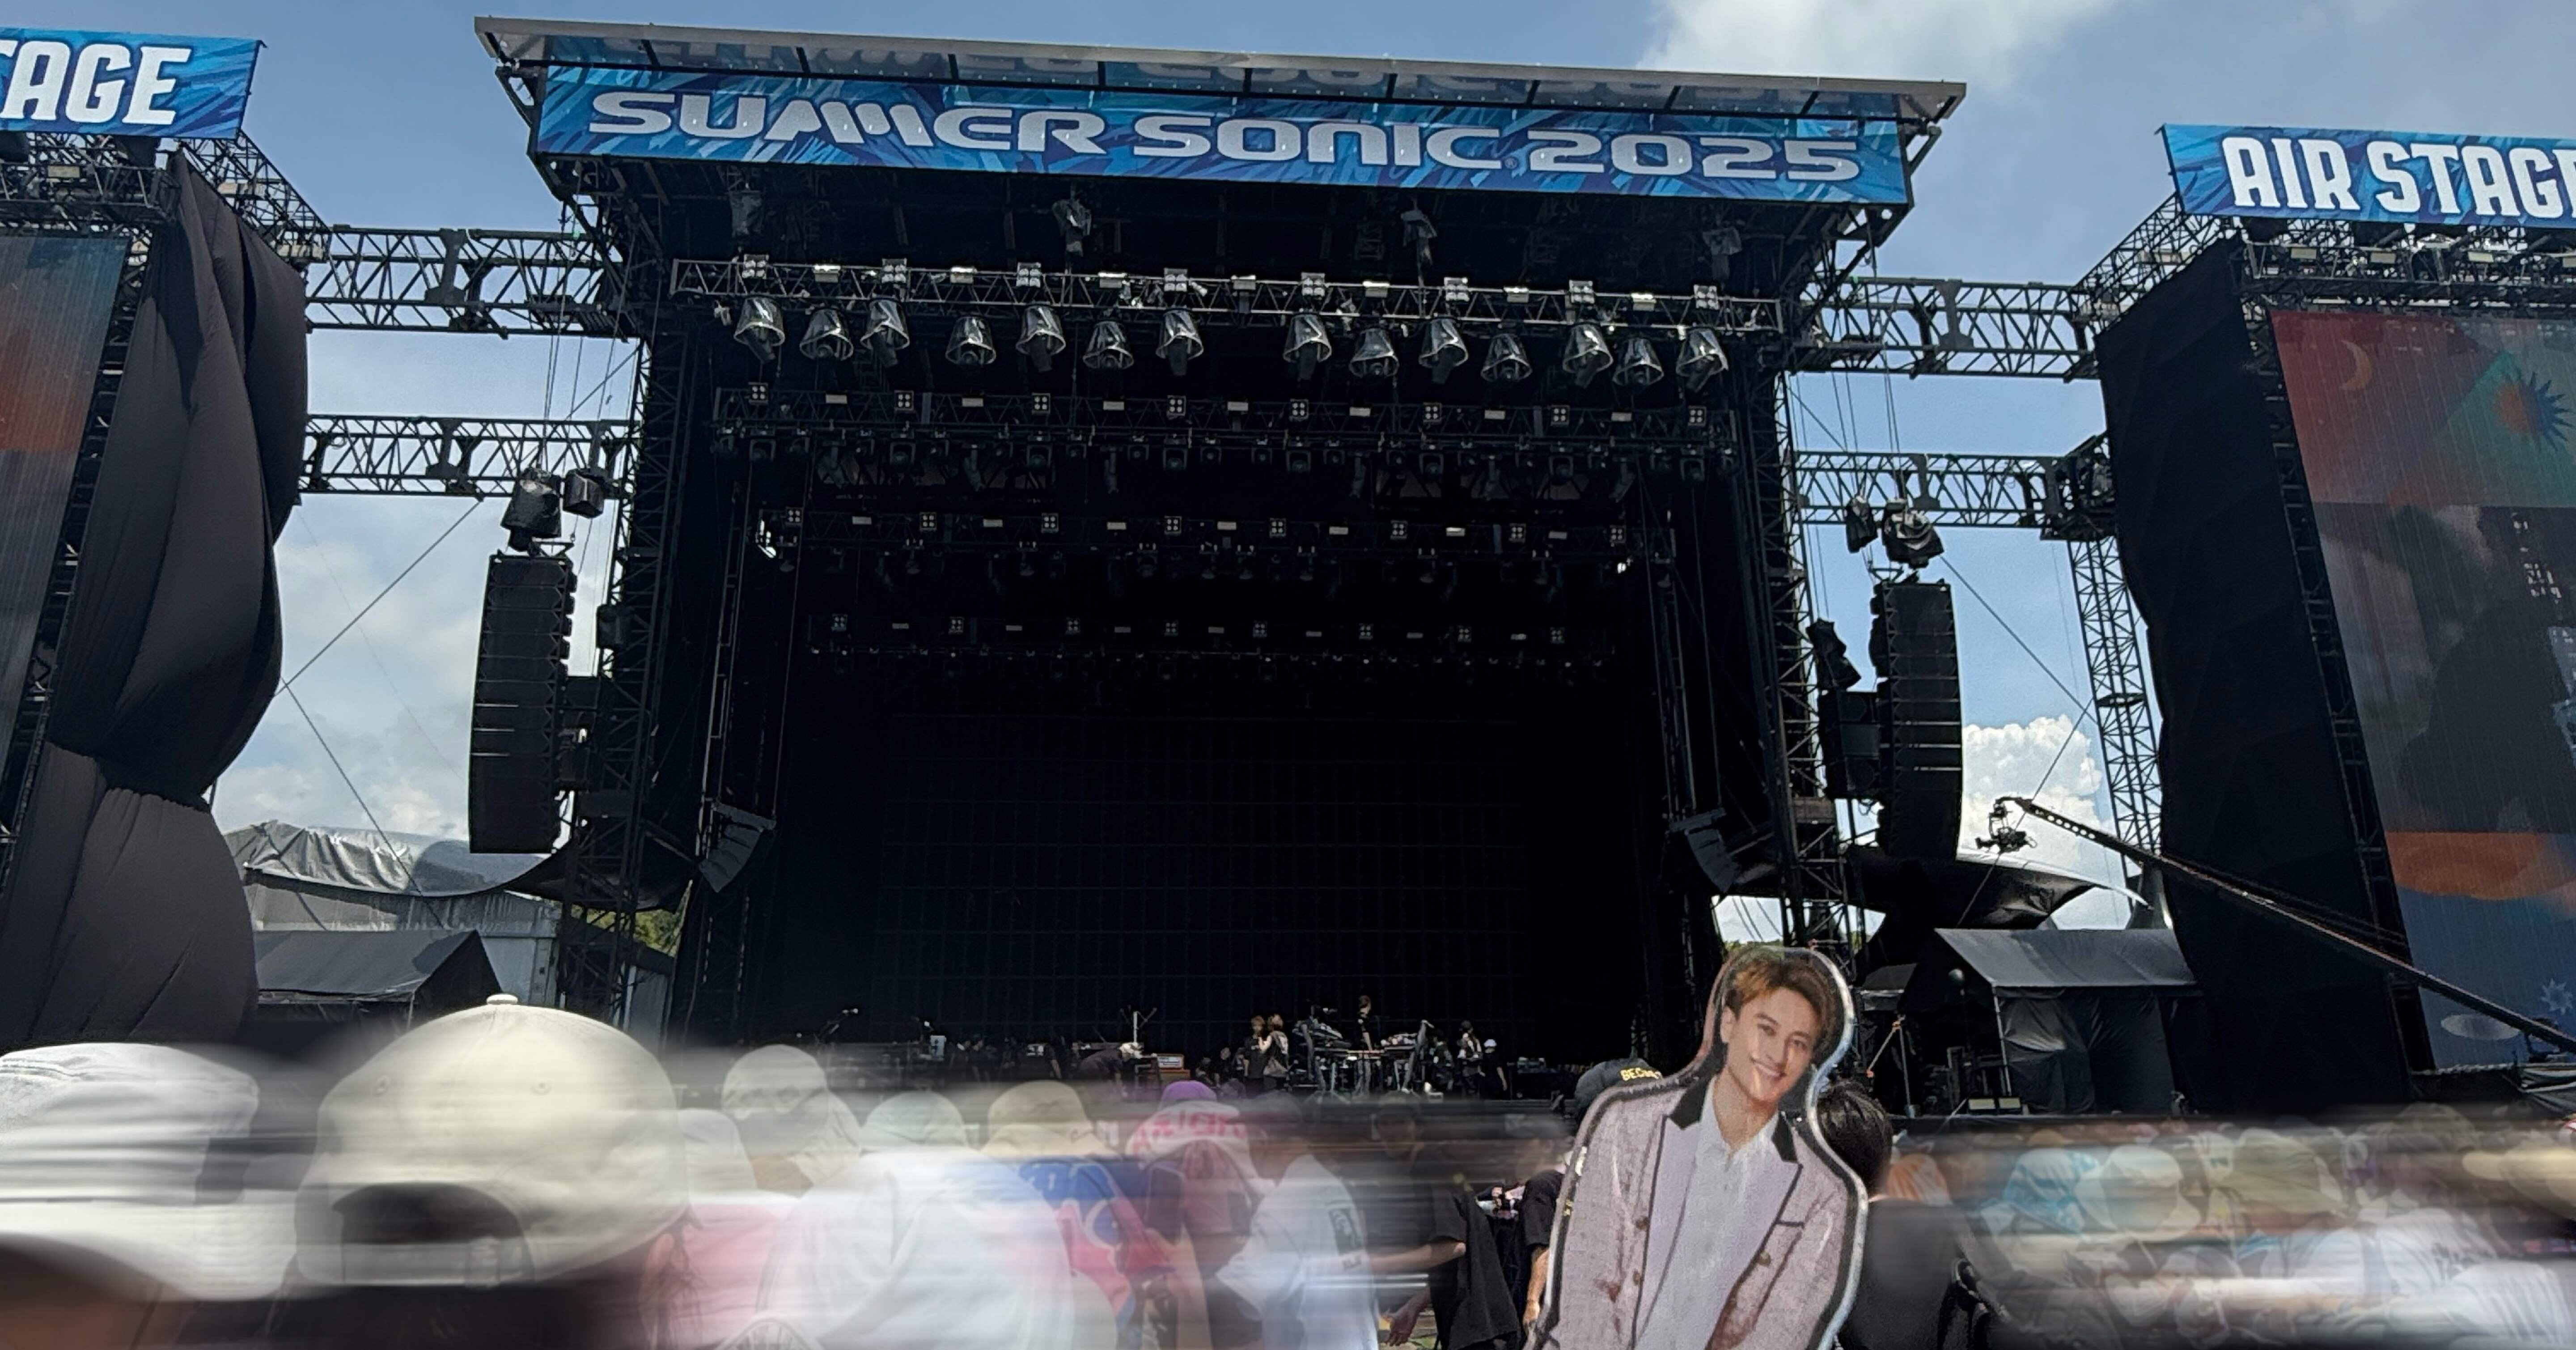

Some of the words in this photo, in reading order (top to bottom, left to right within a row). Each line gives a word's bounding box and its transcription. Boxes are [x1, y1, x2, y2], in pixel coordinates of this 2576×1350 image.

[589, 91, 1107, 154] SUMMER
[1133, 115, 1502, 170] SONIC
[1527, 130, 1860, 181] 2025
[2222, 137, 2361, 210] AIR
